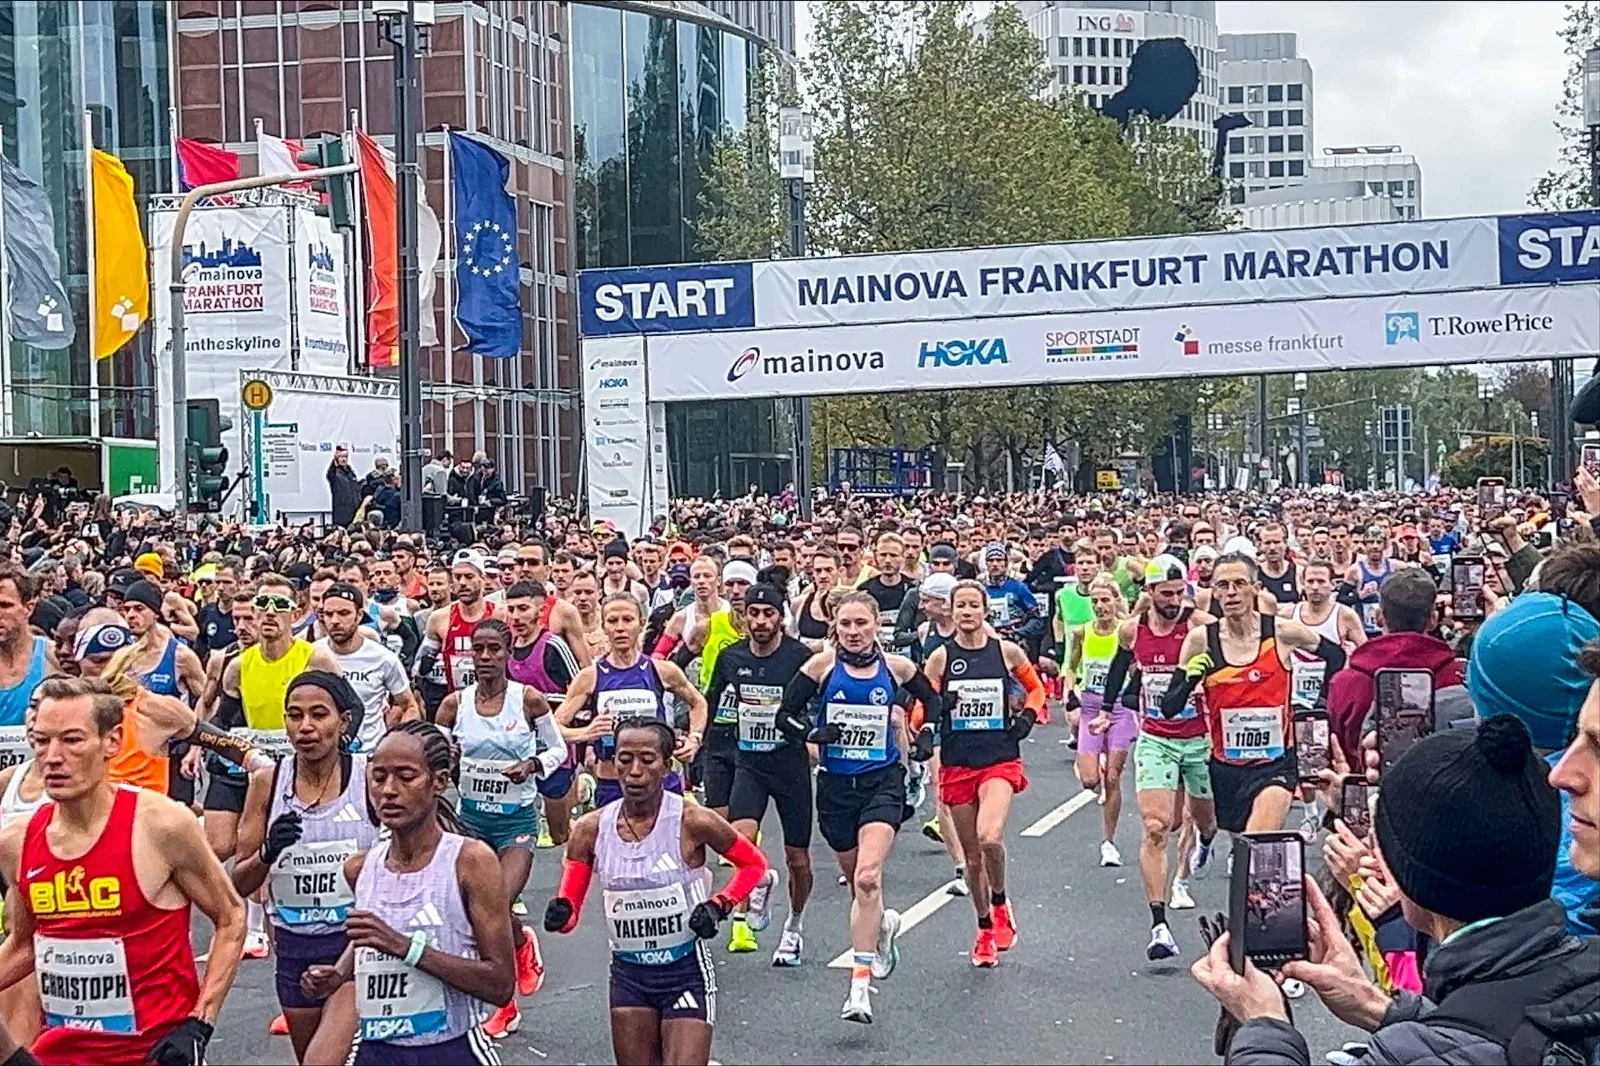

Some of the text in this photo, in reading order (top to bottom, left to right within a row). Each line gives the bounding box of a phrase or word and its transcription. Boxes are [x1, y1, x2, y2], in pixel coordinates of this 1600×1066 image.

[1076, 15, 1111, 32] ING
[199, 268, 263, 281] mainova
[798, 239, 1450, 306] MAINOVA FRANKFURT MARATHON
[184, 284, 263, 297] RANKFURT
[594, 278, 735, 321] START
[1045, 327, 1140, 347] SPORTSTADT
[1208, 334, 1344, 354] messe frankfurt
[917, 338, 1008, 368] HOKA
[763, 350, 885, 375] mainova
[599, 378, 629, 388] HOKA
[959, 702, 994, 718] F3383
[964, 720, 991, 730] HOKA
[749, 726, 777, 741] 10711
[1235, 731, 1271, 747] 11009
[841, 749, 871, 760] HOKA
[472, 778, 510, 794] TEGEST
[475, 801, 504, 814] HOKA
[29, 866, 121, 914] BLC
[293, 872, 337, 895] TSIGE
[624, 896, 678, 911] mainova
[299, 907, 339, 923] HOKA
[613, 912, 684, 939] YALEMGET
[54, 951, 115, 965] mainova
[634, 949, 675, 964] HOKA
[41, 971, 128, 1001] CHRISTOPH
[366, 972, 408, 1000] BUZE
[364, 1018, 415, 1038] HOKA
